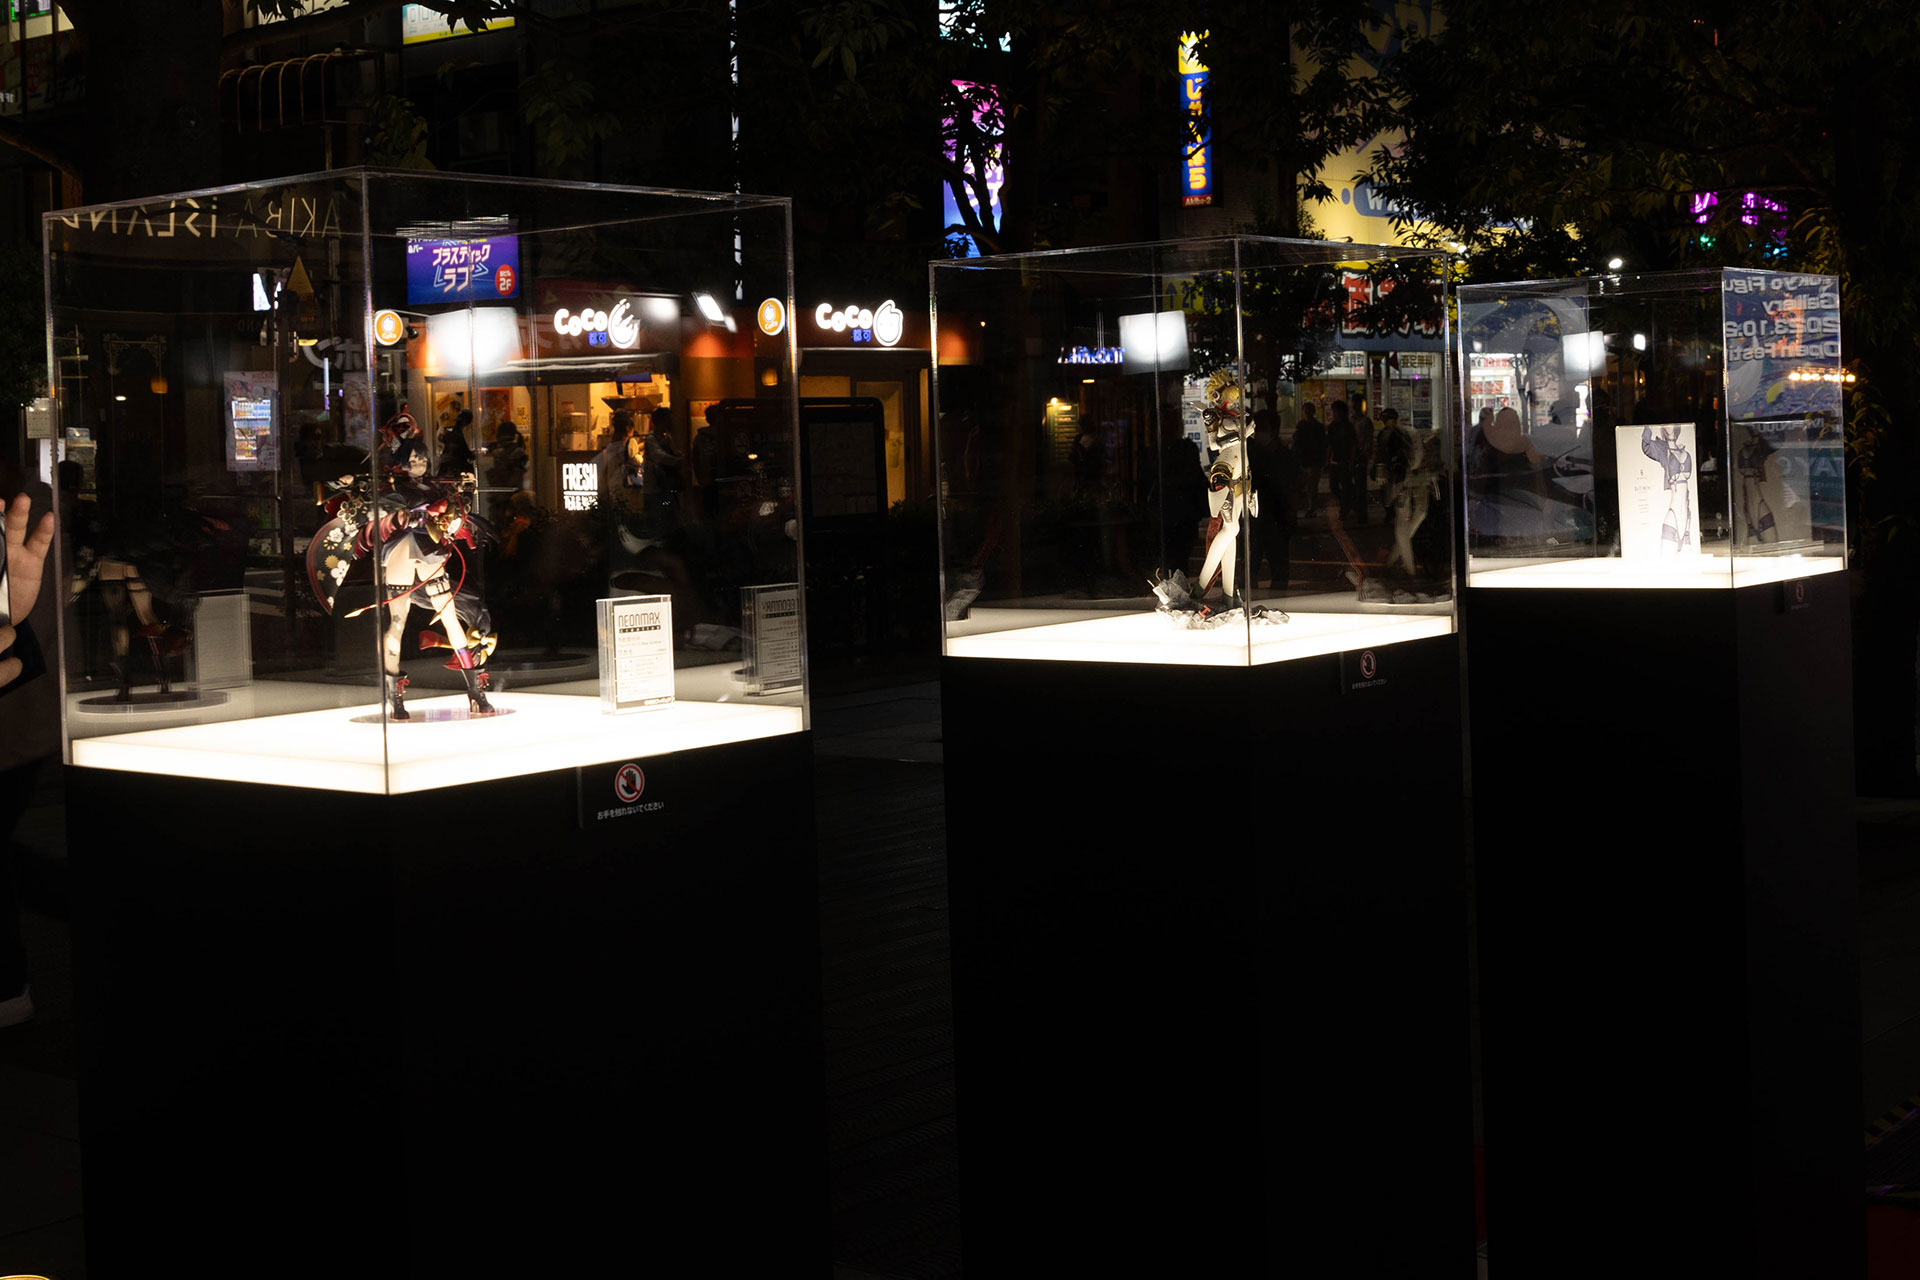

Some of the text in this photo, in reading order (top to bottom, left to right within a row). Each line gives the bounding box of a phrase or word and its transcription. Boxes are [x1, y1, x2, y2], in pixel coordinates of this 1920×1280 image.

[500, 277, 512, 291] 2F
[554, 308, 608, 336] CoCo
[815, 303, 873, 332] CoCo
[563, 463, 598, 490] FRESH
